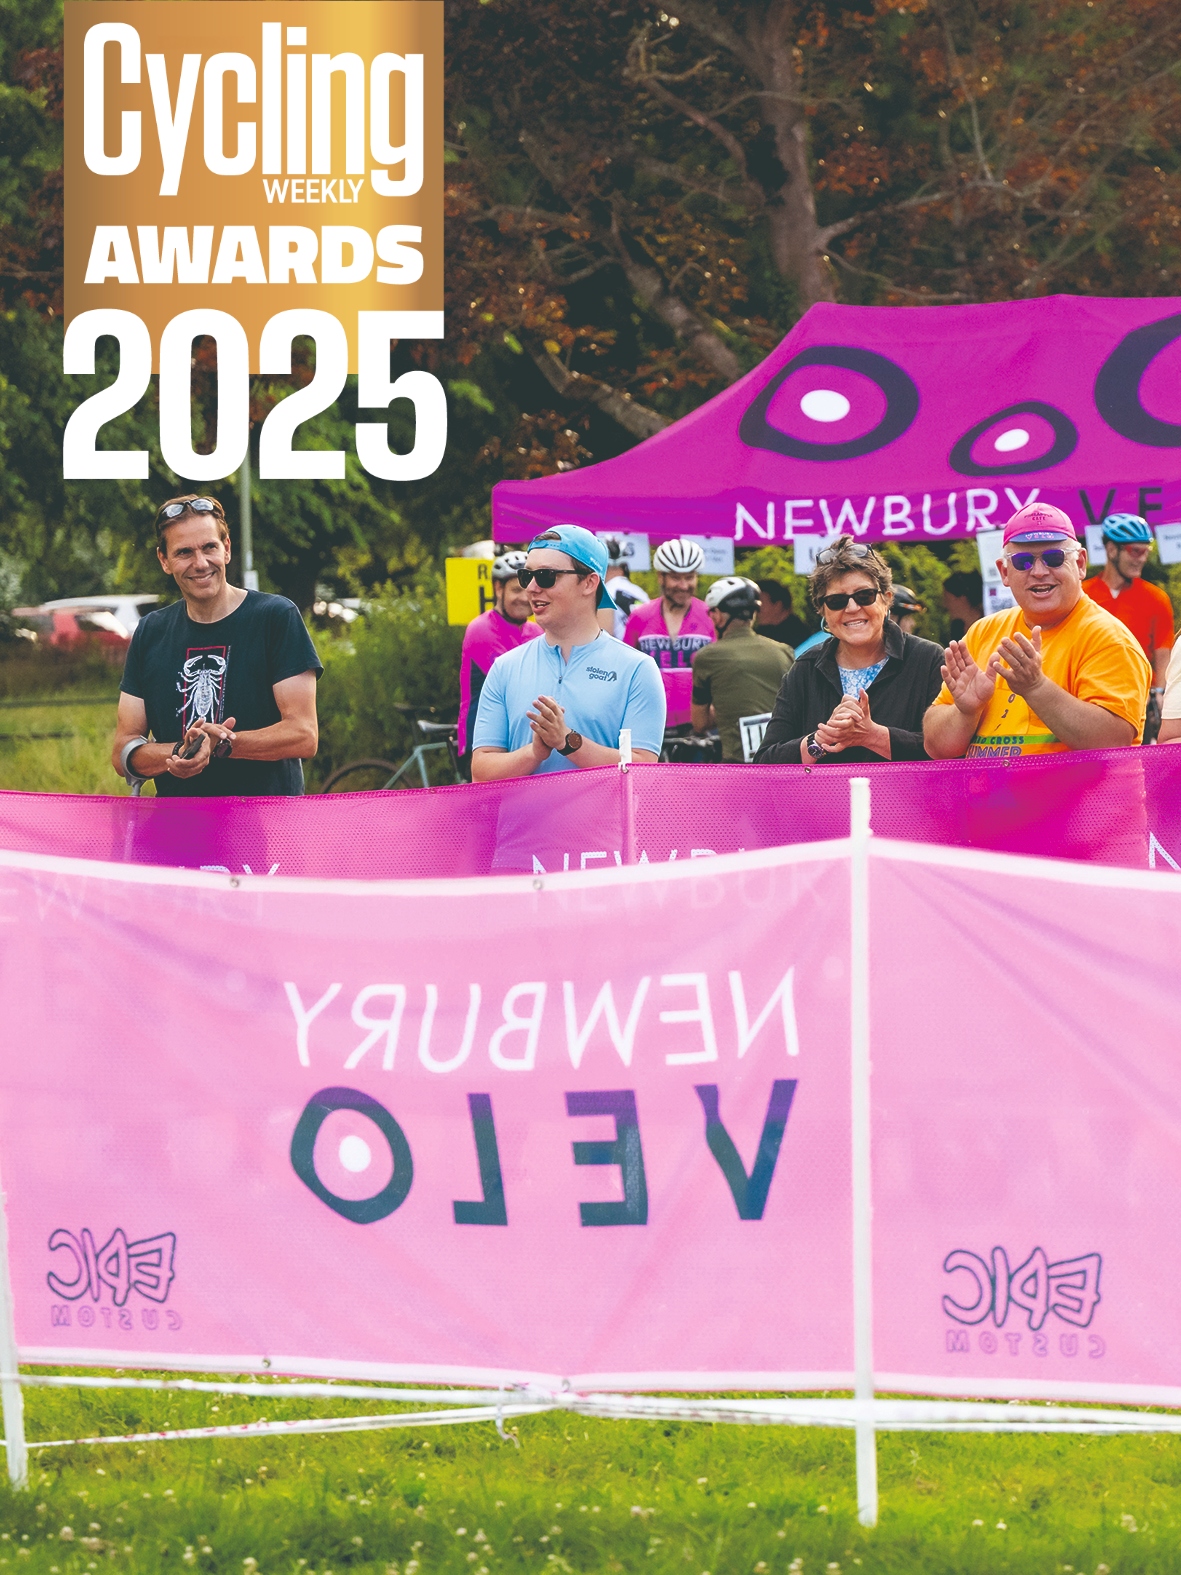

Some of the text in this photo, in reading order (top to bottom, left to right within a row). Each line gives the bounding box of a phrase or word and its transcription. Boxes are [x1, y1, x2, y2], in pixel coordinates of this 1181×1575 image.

[733, 487, 1041, 541] NEWBURY
[586, 665, 609, 677] stolen
[588, 673, 608, 682] goat
[990, 735, 1025, 745] CROSS
